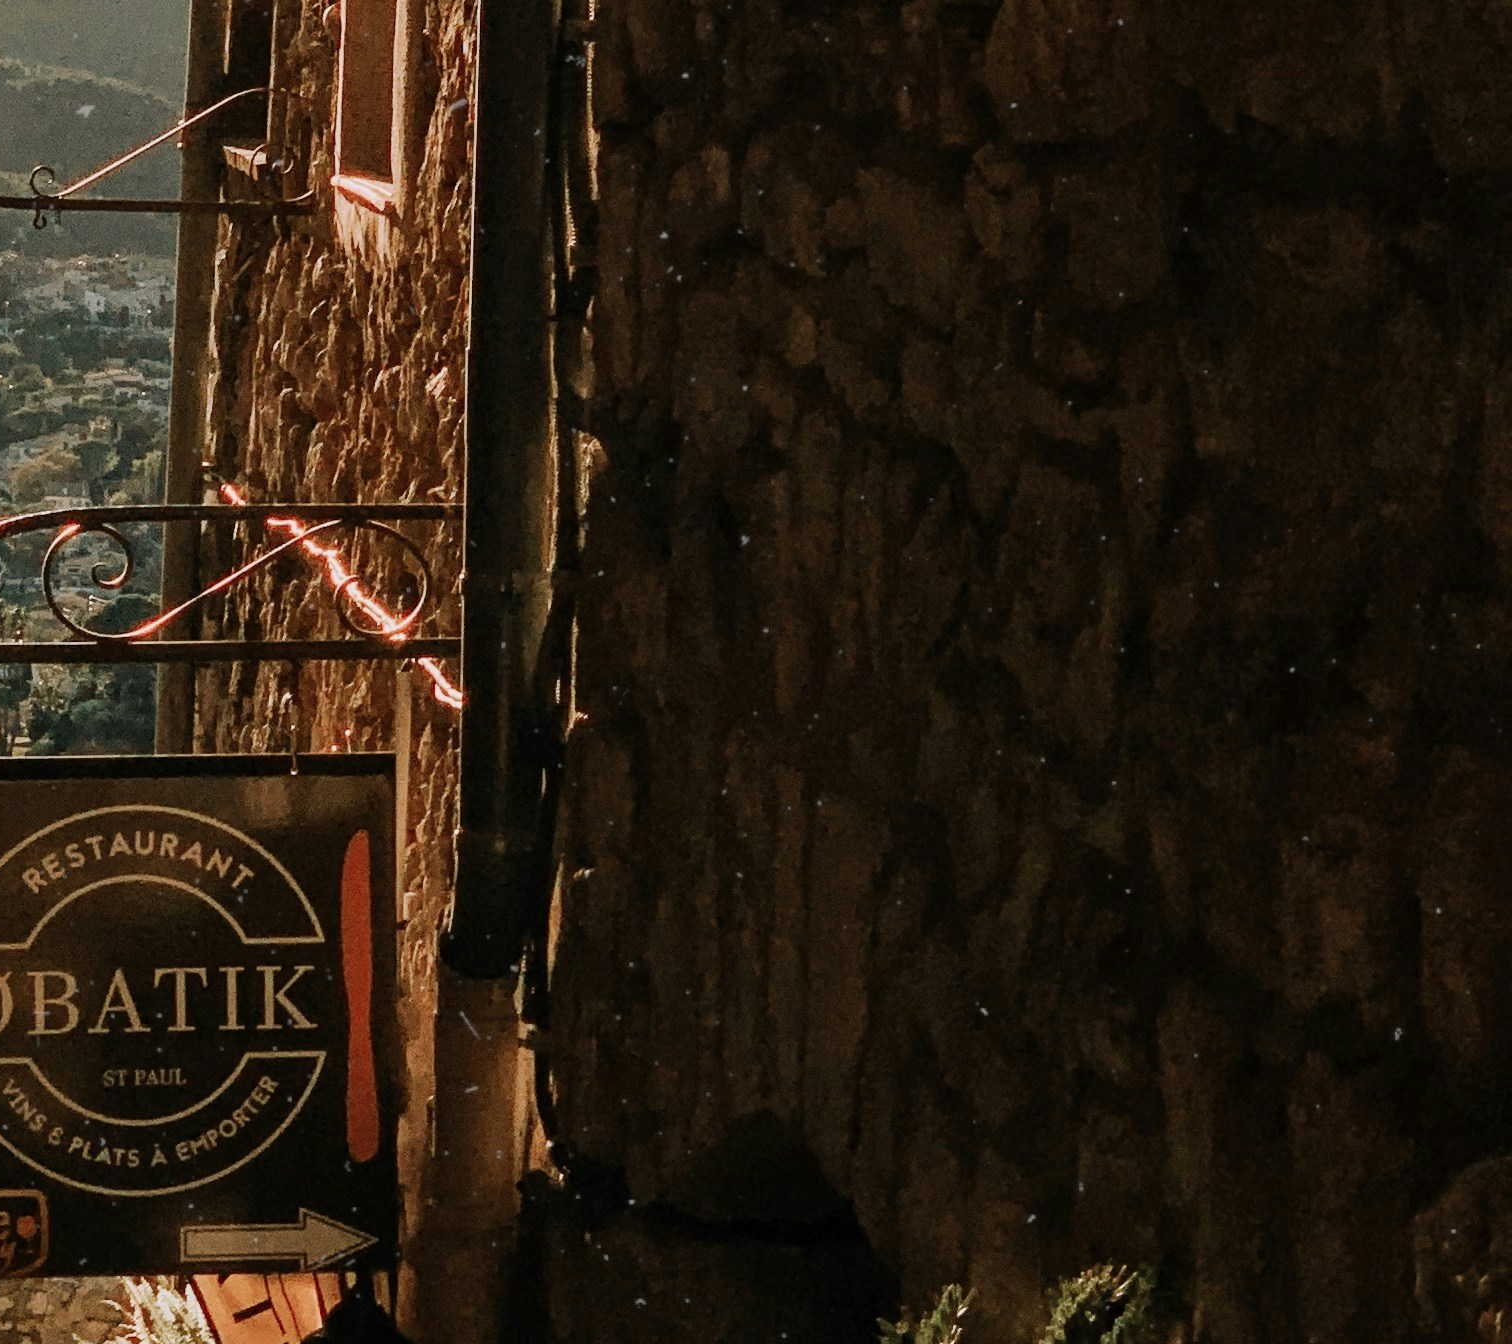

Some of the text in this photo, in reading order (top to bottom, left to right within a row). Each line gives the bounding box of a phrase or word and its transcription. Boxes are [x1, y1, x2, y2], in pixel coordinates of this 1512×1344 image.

[21, 830, 255, 894] RESTAURANT
[102, 1067, 187, 1088] ST PAUL
[2, 1078, 47, 1131] VINS
[68, 1136, 139, 1168] PLATS
[150, 1144, 168, 1167] À
[175, 1074, 280, 1162] EMPORTER
